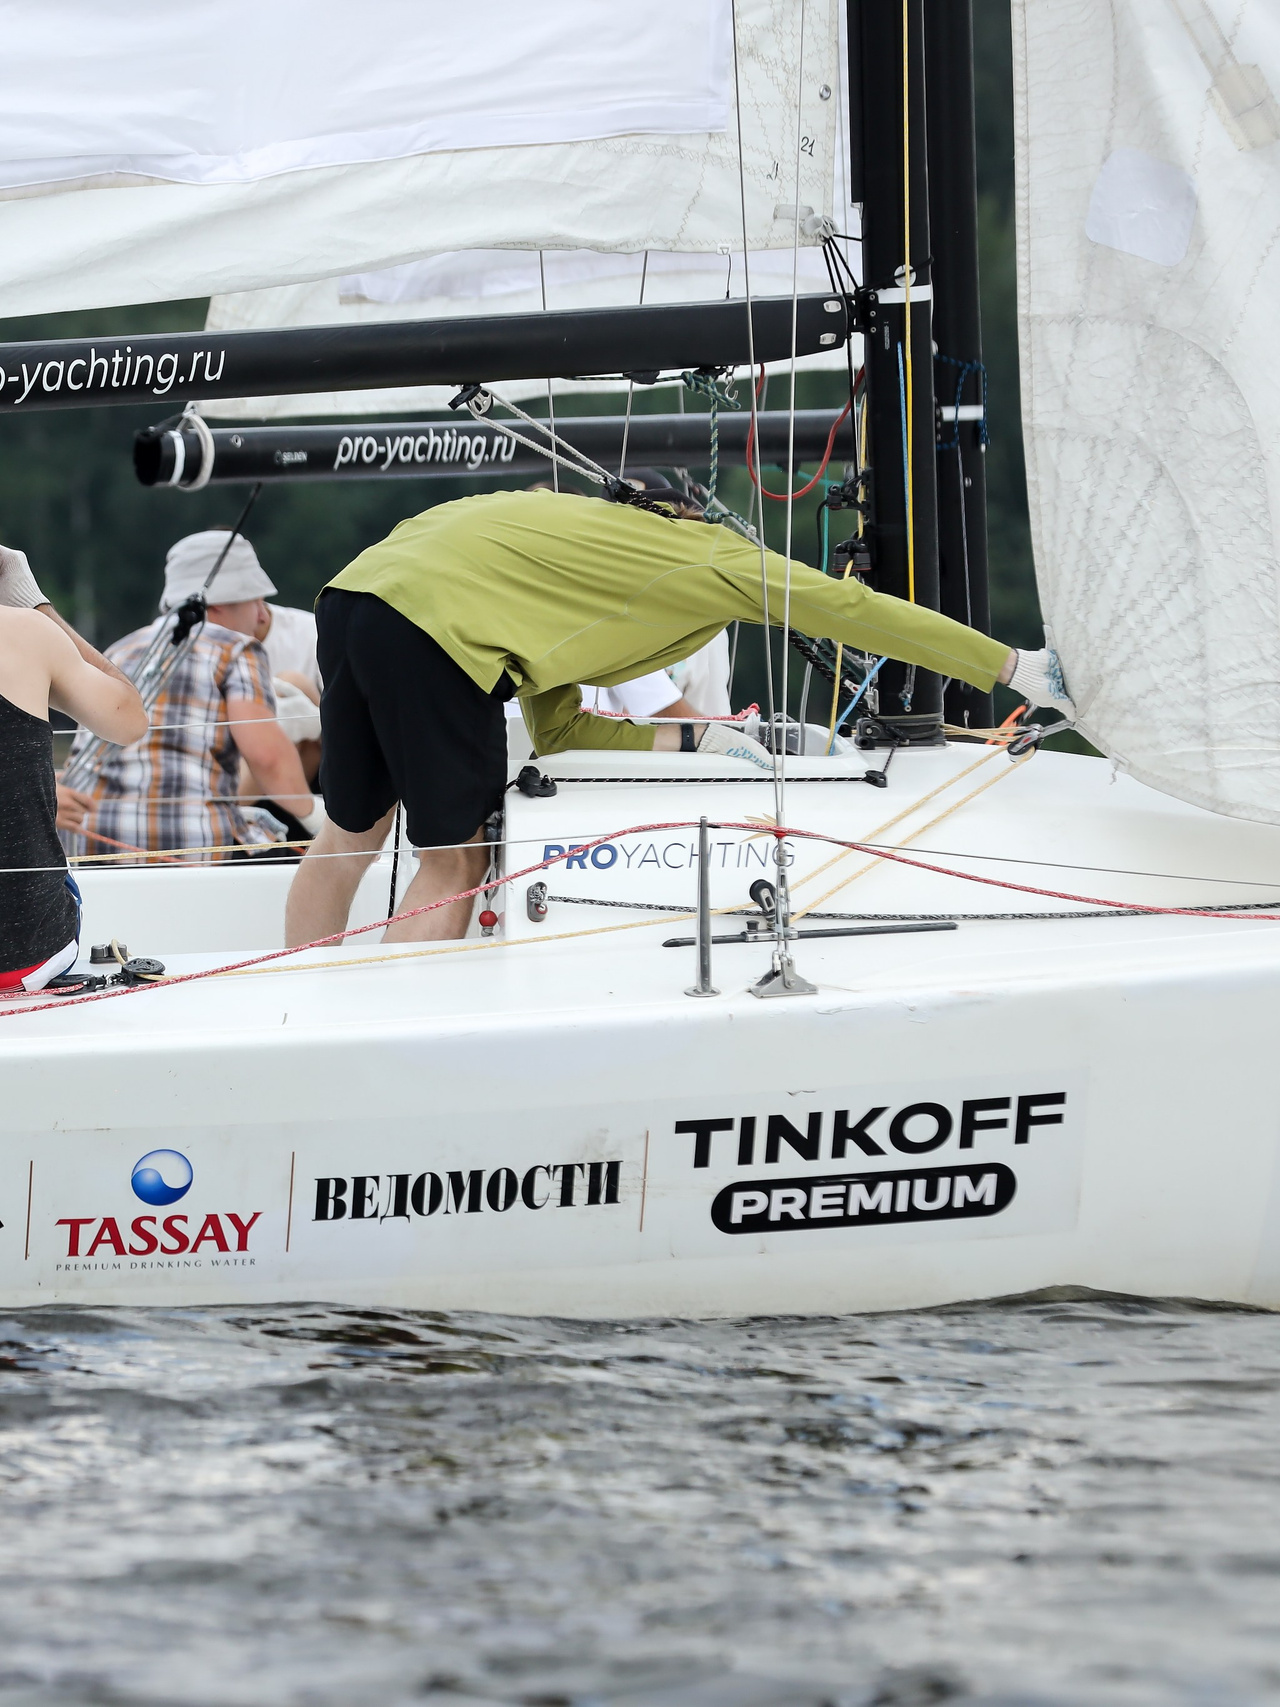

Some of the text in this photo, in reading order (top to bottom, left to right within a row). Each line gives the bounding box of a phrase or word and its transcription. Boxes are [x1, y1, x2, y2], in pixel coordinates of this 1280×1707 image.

[333, 428, 517, 471] pro-yachting.ru
[674, 1091, 1068, 1169] TINKOFF
[311, 1160, 624, 1225] ВЕДОМОСТИ
[729, 1173, 999, 1225] PREMIUM
[55, 1212, 263, 1257] TASSAY
[56, 1258, 256, 1272] PREMIUM DRINKING WATER
